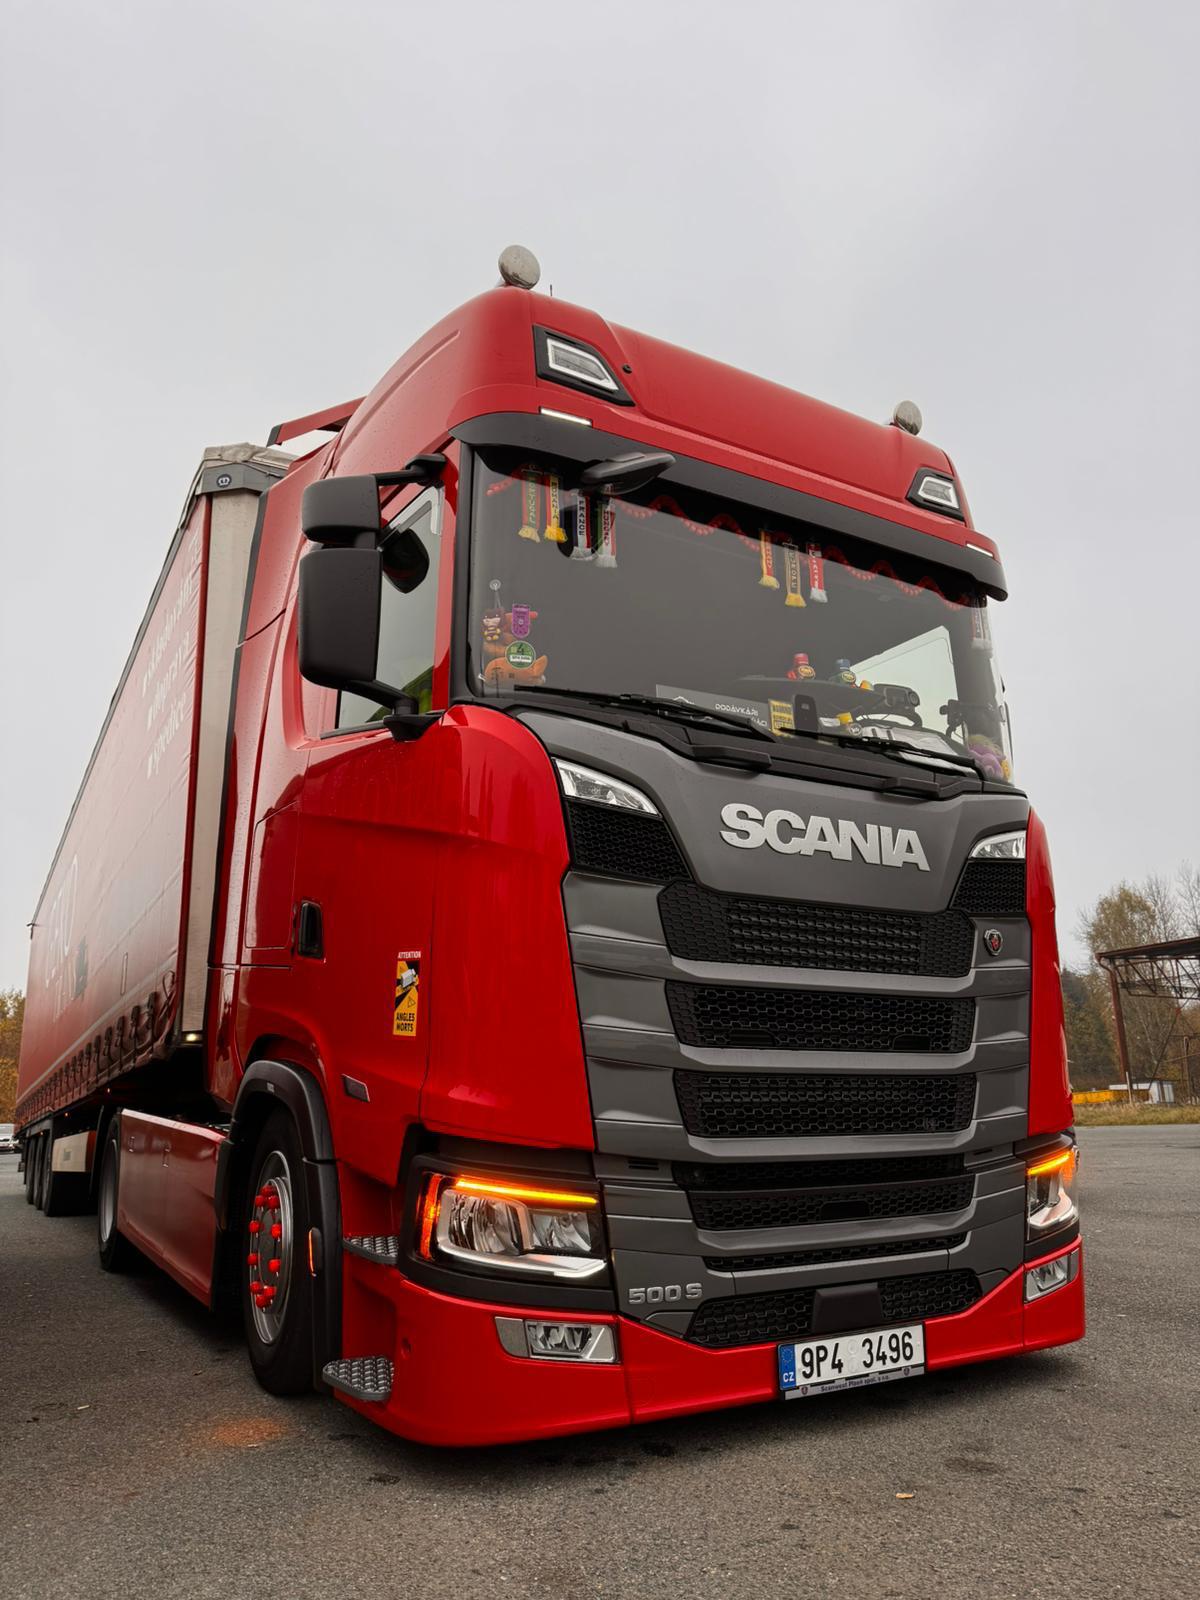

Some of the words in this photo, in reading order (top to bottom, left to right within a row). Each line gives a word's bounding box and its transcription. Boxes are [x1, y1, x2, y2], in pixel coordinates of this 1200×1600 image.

[578, 500, 586, 536] FRANCE
[719, 803, 931, 872] SCANIA
[397, 951, 421, 959] ATTENTION
[396, 1012, 415, 1022] ANGLES
[396, 1022, 414, 1032] MORTS
[629, 1285, 681, 1305] 500
[685, 1282, 702, 1300] S
[801, 1342, 844, 1379] 9P4
[862, 1331, 914, 1368] 3496
[782, 1372, 795, 1383] CZ
